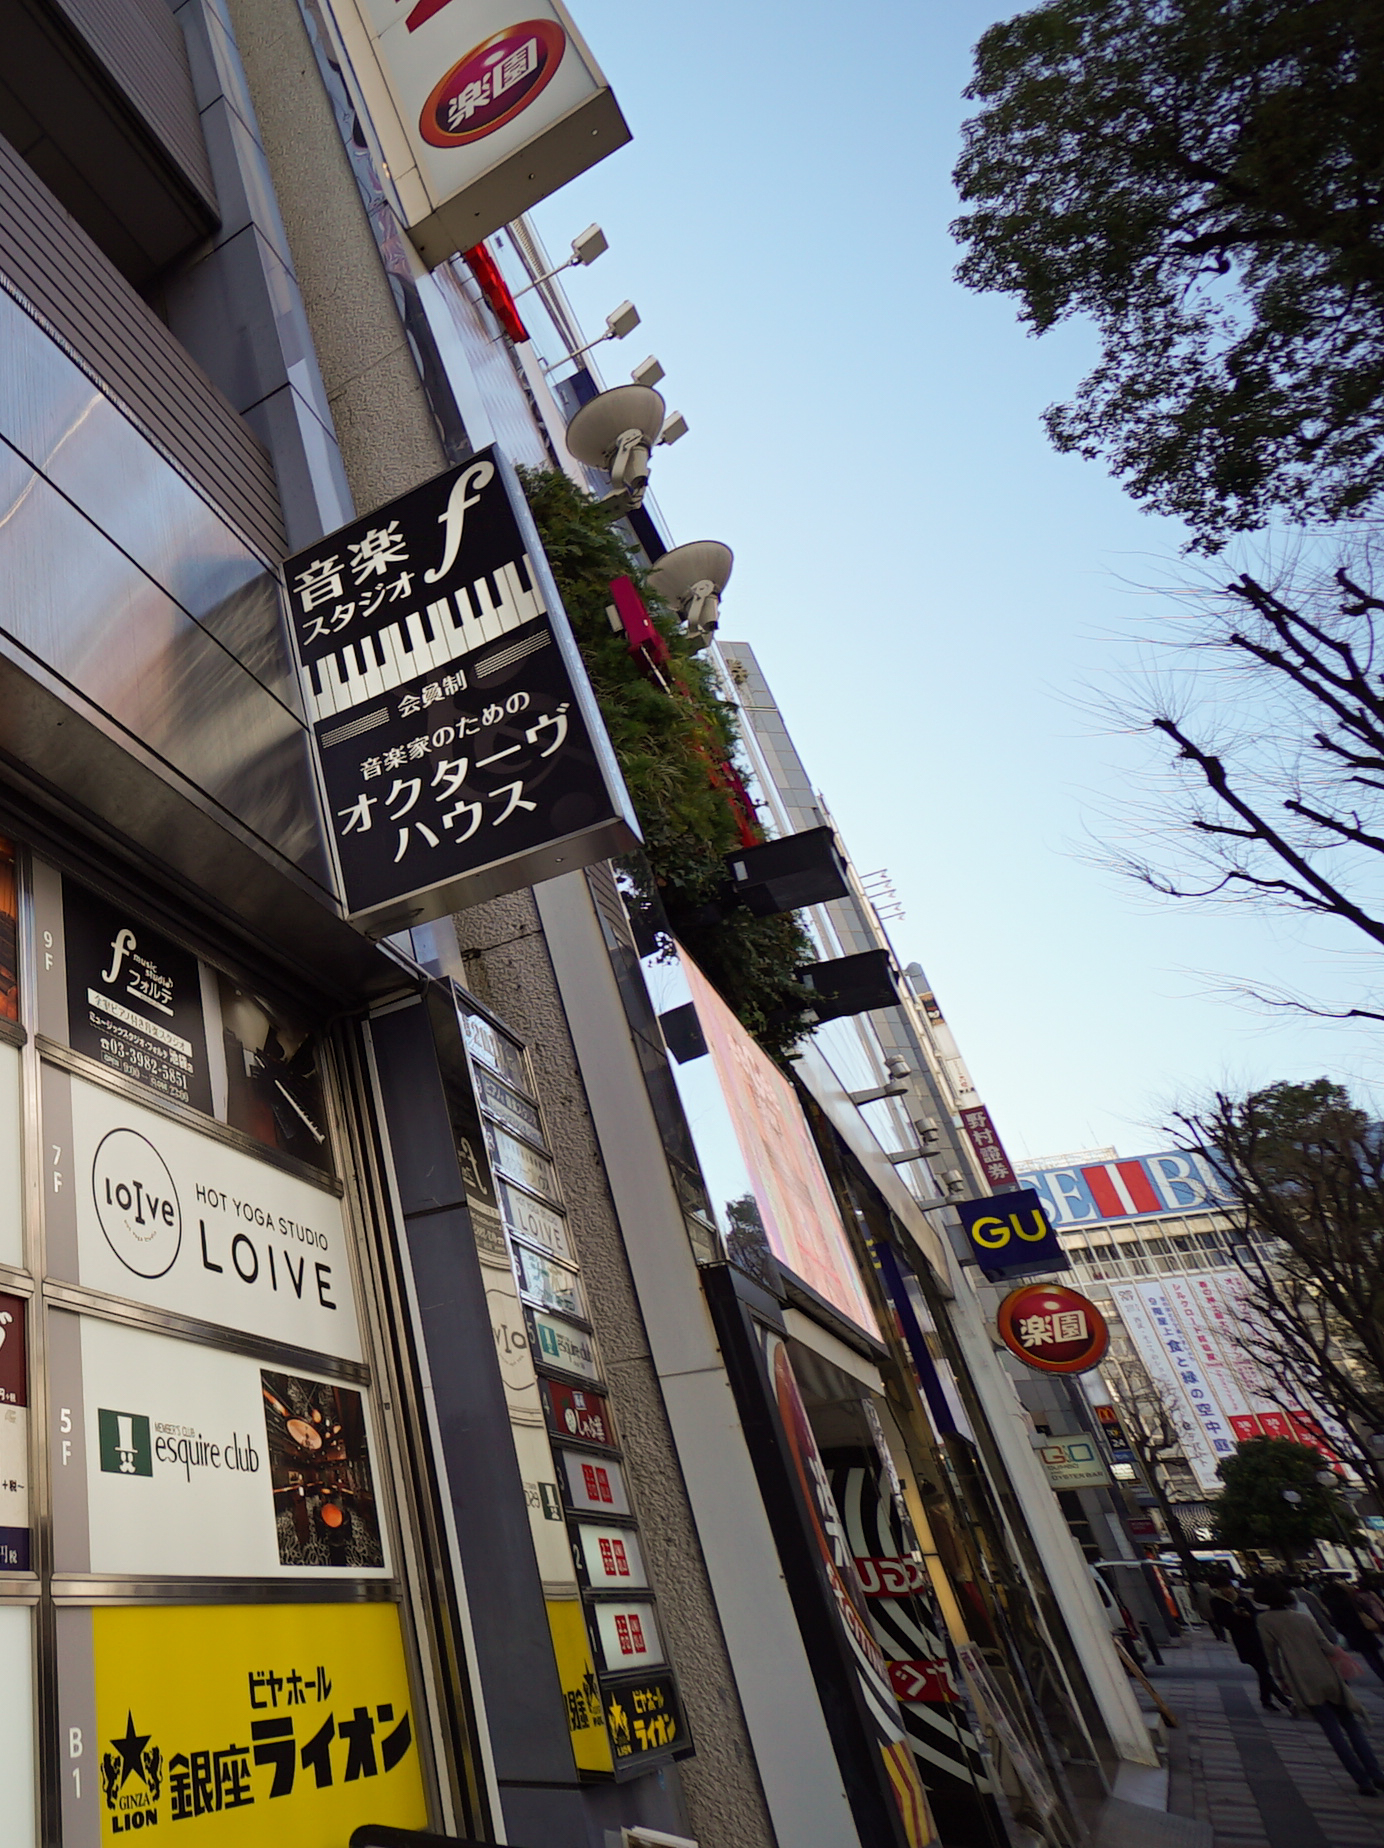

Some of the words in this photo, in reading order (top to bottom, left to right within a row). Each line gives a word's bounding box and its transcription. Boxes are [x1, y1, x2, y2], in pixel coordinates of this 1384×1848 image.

[447, 37, 538, 132] 楽園
[293, 519, 411, 613] 音楽
[302, 571, 415, 647] スタジオ
[398, 669, 468, 719] 会員制
[359, 690, 531, 781] 音楽家のための
[337, 701, 571, 836] オクターヴ
[393, 780, 538, 863] ハウス
[129, 969, 174, 1004] フォルテ
[133, 953, 157, 973] music
[110, 1038, 188, 1090] 03-3982-5851
[965, 1111, 1010, 1181] 野村證券
[195, 1183, 227, 1212] HOT
[231, 1197, 276, 1232] YOGA
[277, 1217, 329, 1252] STUDIO
[971, 1209, 1047, 1249] GU
[199, 1219, 338, 1310] LOIVE
[1019, 1310, 1088, 1348] 楽園
[155, 1432, 221, 1483] esquire
[225, 1431, 259, 1473] club
[182, 1426, 196, 1438] CLUB
[248, 1665, 332, 1710] ビヤホール
[633, 1713, 676, 1751] ライオン
[112, 1807, 158, 1834] LION
[119, 1793, 151, 1812] GINZA
